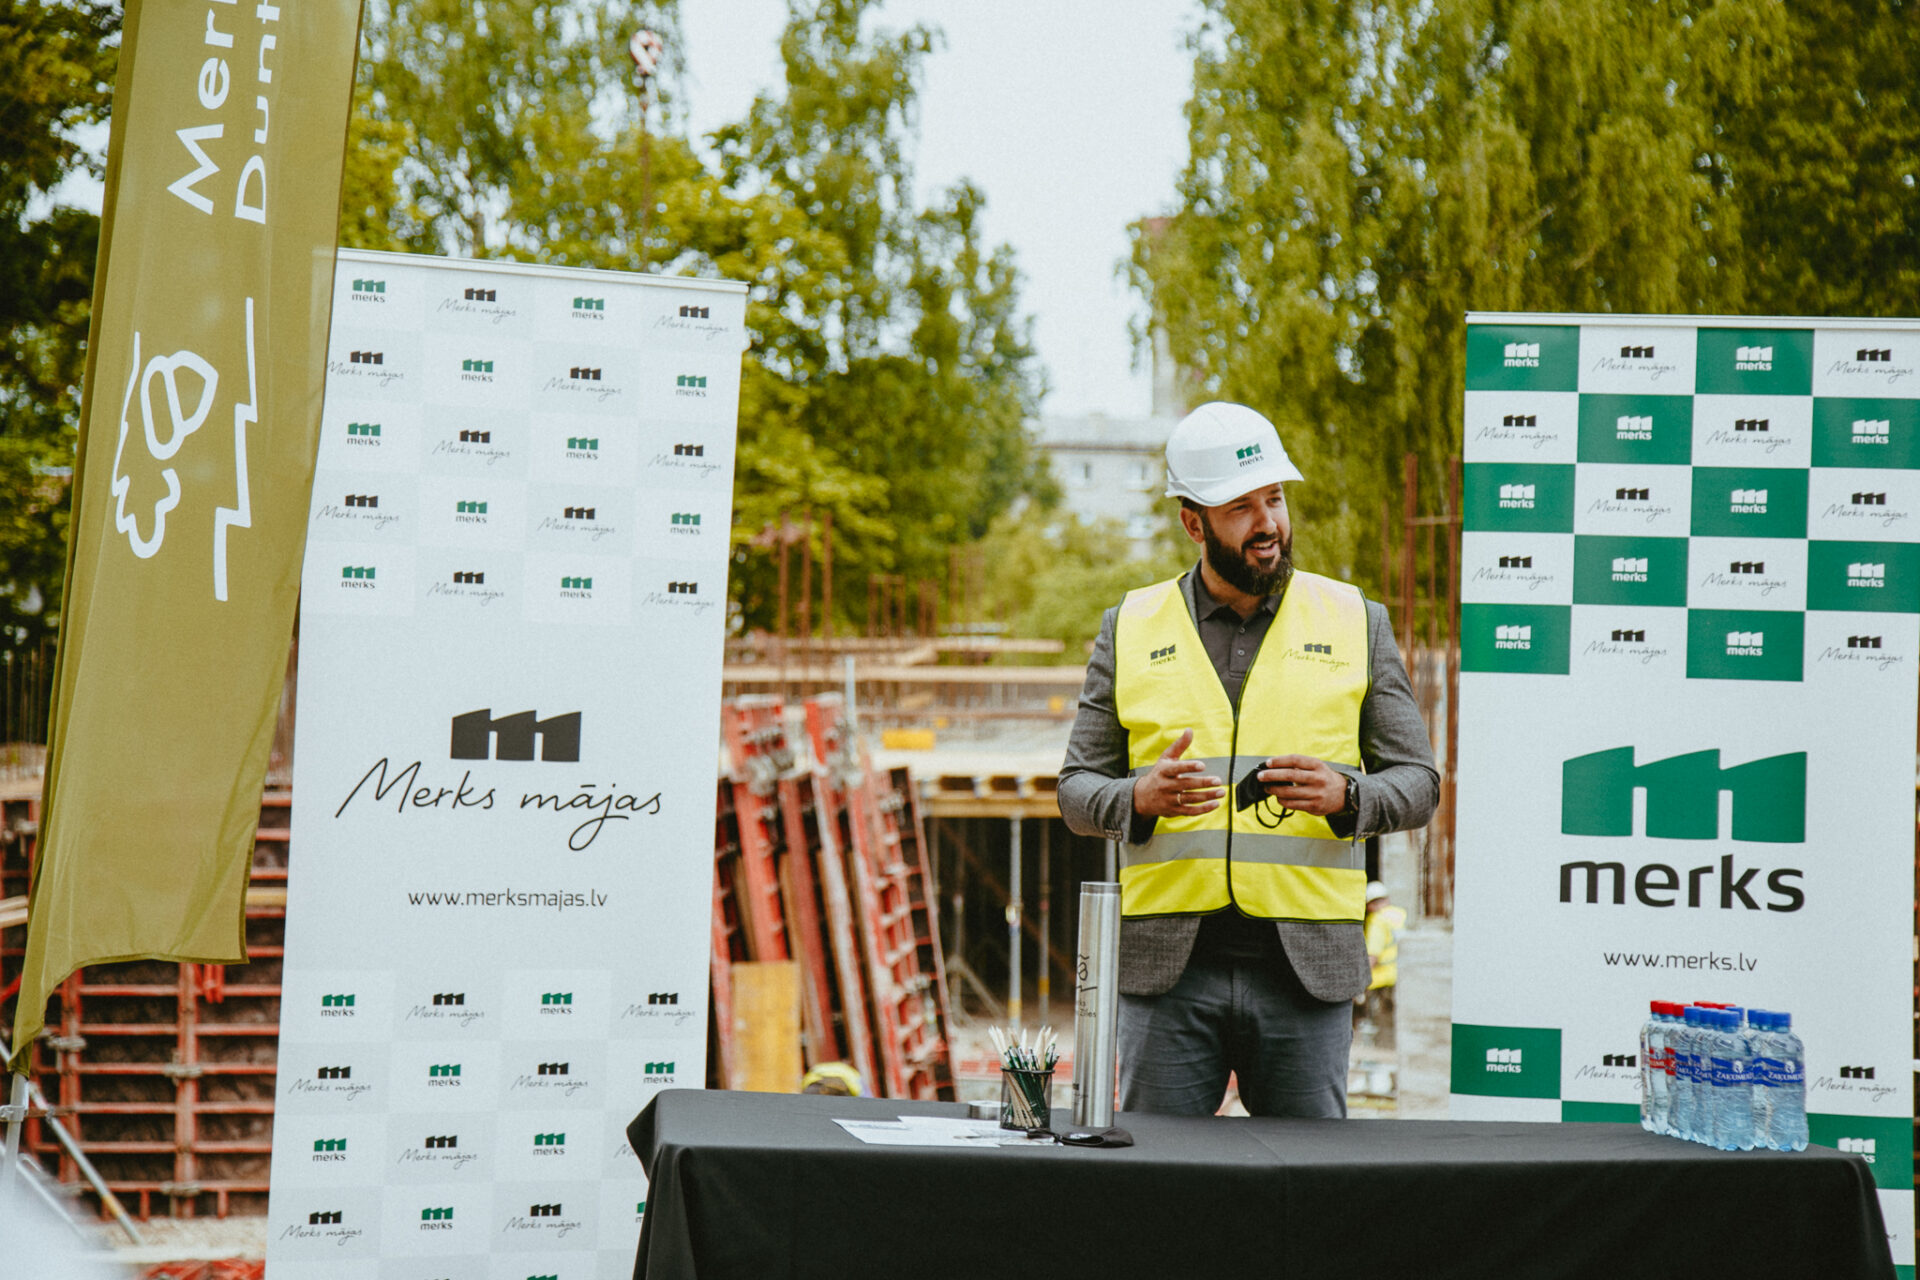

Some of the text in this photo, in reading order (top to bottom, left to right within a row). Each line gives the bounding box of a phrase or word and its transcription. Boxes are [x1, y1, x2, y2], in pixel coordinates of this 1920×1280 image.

[166, 0, 239, 216] Mer
[351, 293, 385, 303] merks
[572, 310, 604, 320] merks
[1504, 357, 1539, 368] merks
[1736, 361, 1773, 371] merks
[461, 373, 493, 383] merks
[676, 388, 706, 397] merks
[1616, 430, 1652, 440] merks
[1852, 434, 1889, 444] merks
[347, 436, 380, 446] merks
[566, 451, 598, 460] merks
[1239, 455, 1265, 468] merks
[1500, 499, 1534, 508] merks
[1731, 503, 1767, 514] merks
[456, 515, 487, 524] merks
[670, 526, 700, 535] merks
[1612, 571, 1647, 582] merks
[341, 580, 375, 589] merks
[1847, 577, 1884, 587] merks
[560, 590, 591, 599] merks
[1495, 639, 1531, 649] merks
[1726, 646, 1762, 656] merks
[335, 757, 661, 851] Merks mājas
[1560, 854, 1805, 912] merks
[408, 887, 608, 912] www.merksmajas.lv
[1603, 951, 1758, 971] www.merks.lv
[321, 1008, 355, 1017] merks
[540, 1007, 572, 1015] merks
[1486, 1063, 1521, 1072] merks
[428, 1078, 460, 1087] merks
[643, 1075, 674, 1084] merks
[533, 1147, 565, 1155] merks
[312, 1153, 346, 1162] merks
[421, 1221, 453, 1230] merks
